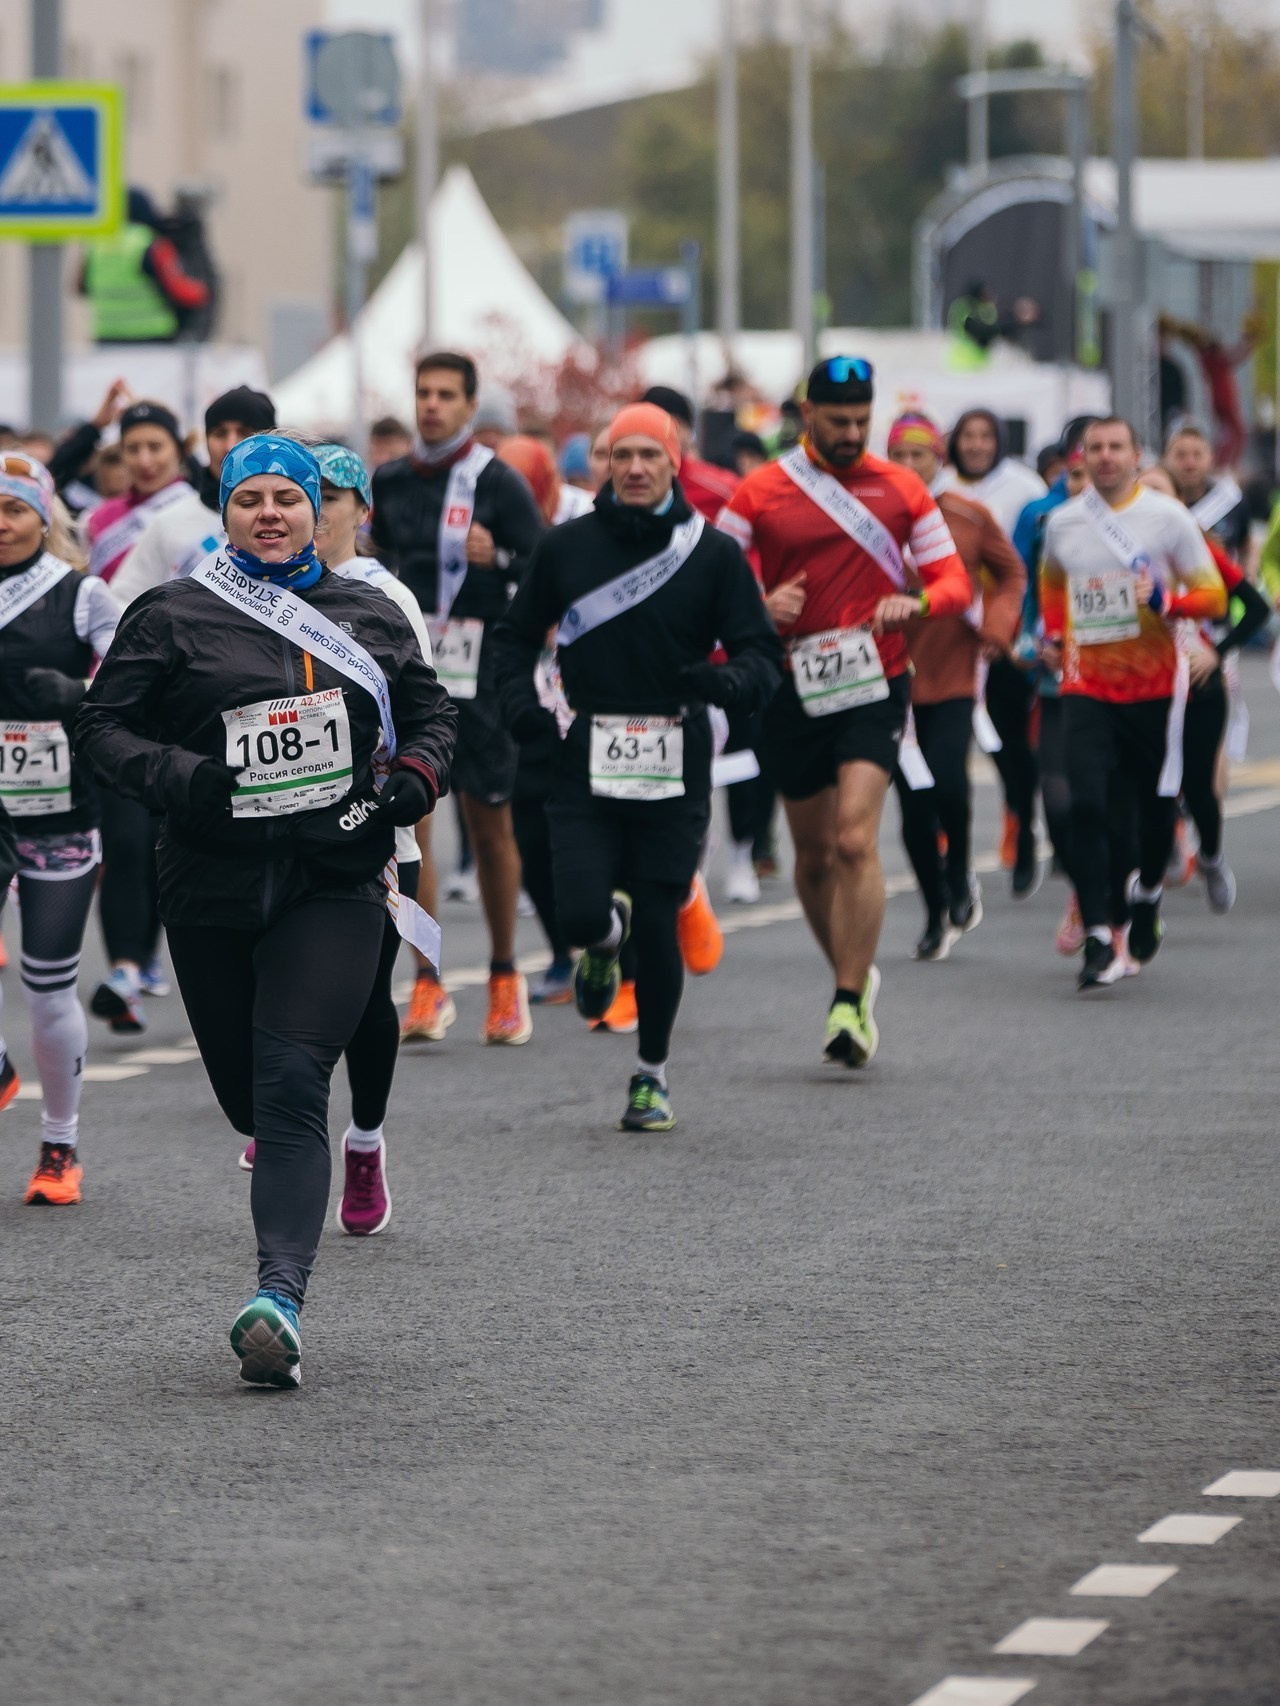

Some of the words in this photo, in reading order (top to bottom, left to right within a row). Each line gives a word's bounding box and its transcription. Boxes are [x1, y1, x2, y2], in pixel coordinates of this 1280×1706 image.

[205, 570, 274, 618] КОРПОРАТИВНАЯ
[215, 556, 282, 608] ЭСТАФЕТА
[277, 603, 298, 626] 108
[299, 623, 346, 659] СЕГОДНЯ
[347, 657, 384, 694] РОССИЯ
[802, 644, 871, 682] 127-1
[300, 694, 322, 707] 42,2
[236, 718, 340, 768] 108-1
[607, 736, 667, 762] 63-1
[250, 769, 289, 782] Россия
[291, 761, 334, 776] сегодня
